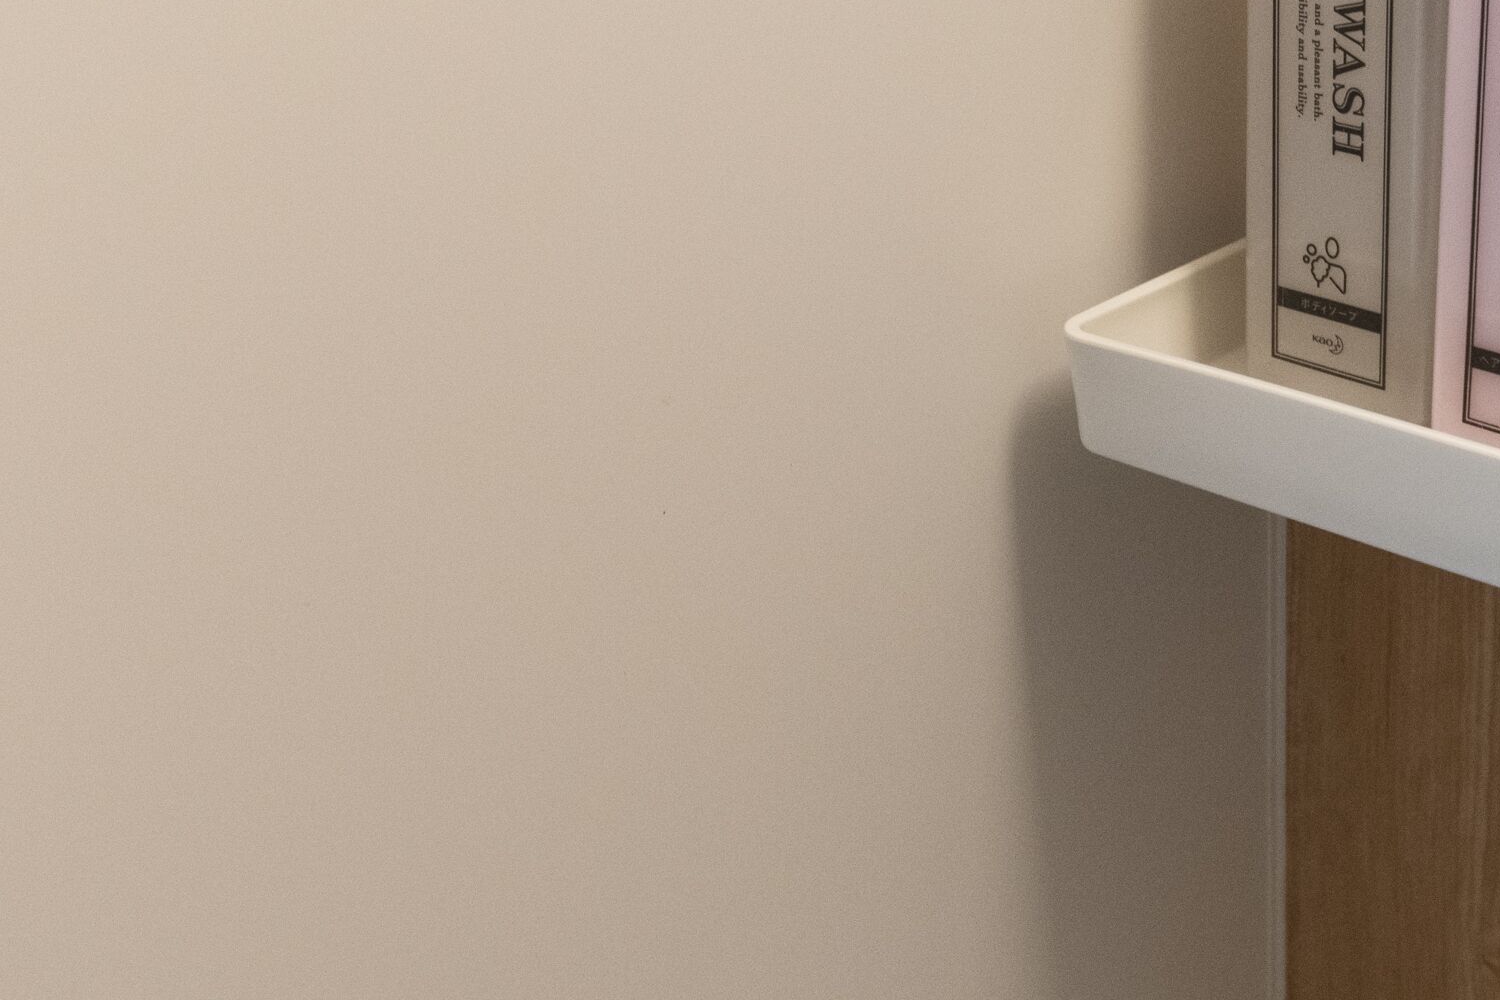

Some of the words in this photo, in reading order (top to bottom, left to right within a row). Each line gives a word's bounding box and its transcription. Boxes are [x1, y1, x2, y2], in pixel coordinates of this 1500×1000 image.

[1313, 1, 1325, 27] and
[1296, 36, 1308, 61] and
[1310, 37, 1325, 90] pleasant
[1294, 62, 1308, 118] usability.
[1312, 91, 1324, 122] bath.
